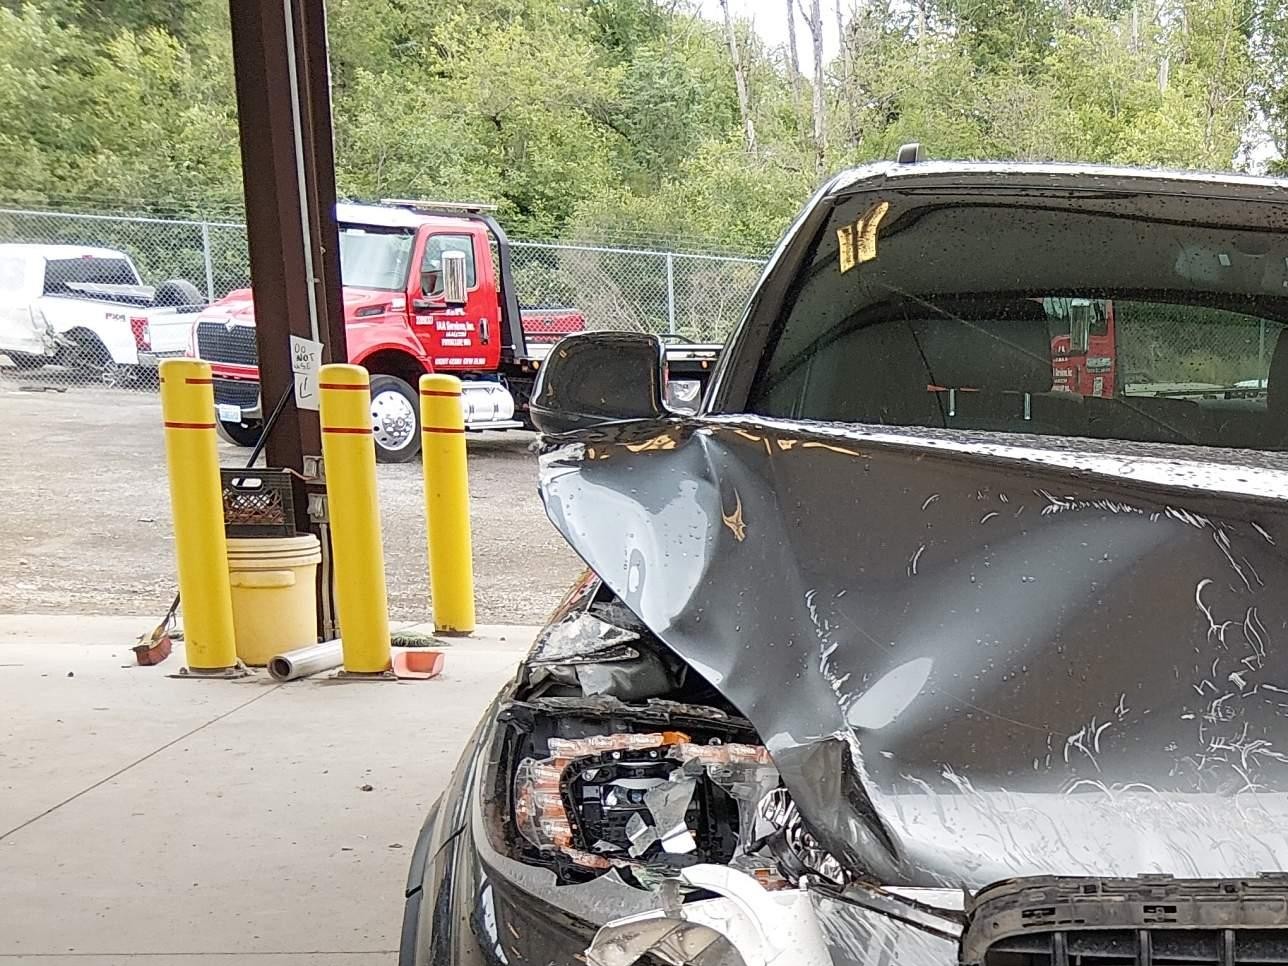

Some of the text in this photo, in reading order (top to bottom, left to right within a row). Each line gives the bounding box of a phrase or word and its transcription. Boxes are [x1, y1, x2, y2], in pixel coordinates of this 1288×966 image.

[294, 343, 306, 354] DO
[296, 352, 315, 362] NOT
[293, 362, 311, 370] USE
